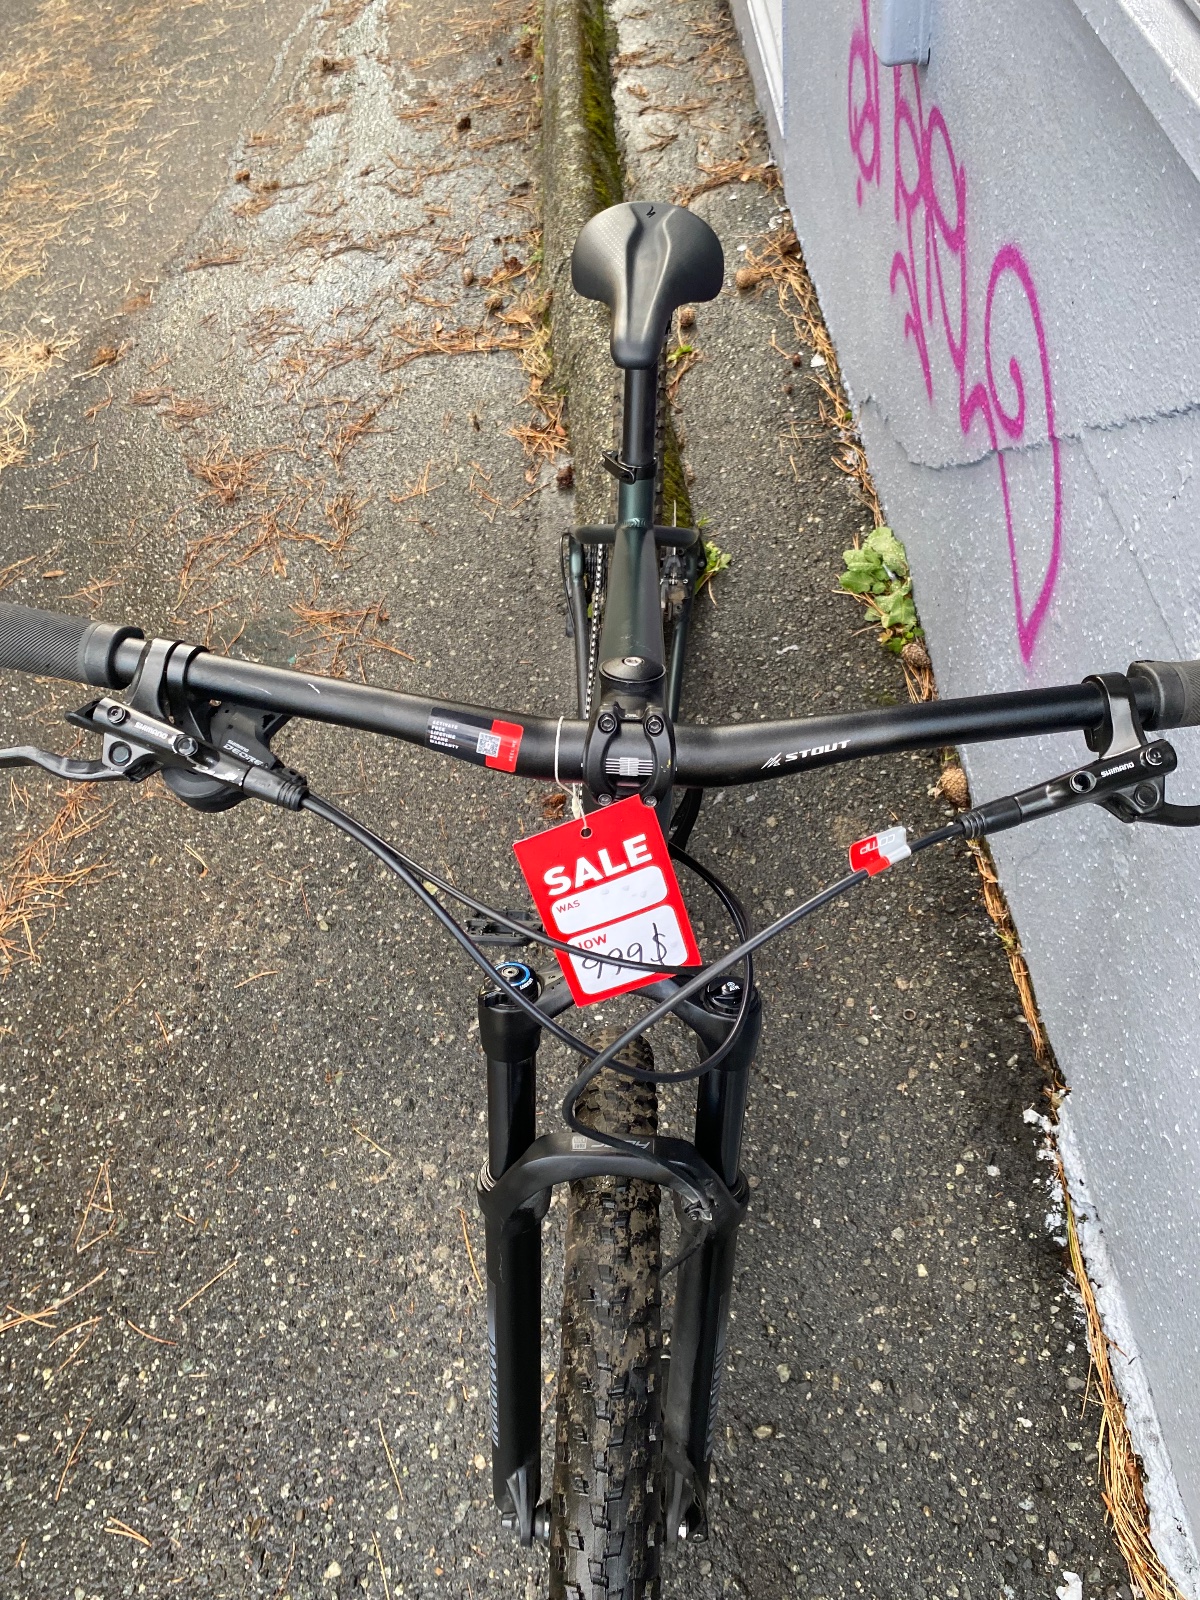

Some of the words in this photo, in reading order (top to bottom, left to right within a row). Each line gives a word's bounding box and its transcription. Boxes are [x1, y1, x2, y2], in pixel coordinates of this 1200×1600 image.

[134, 721, 168, 740] SHIMANO
[432, 720, 458, 730] ACTIVATE
[429, 735, 449, 743] FRAME
[430, 730, 456, 740] LIFETIME
[429, 739, 459, 749] WARRANTY
[785, 740, 851, 762] STOUT
[223, 743, 264, 767] DEORE
[1100, 761, 1135, 778] SHIMANO
[543, 833, 653, 895] SALE
[556, 900, 581, 914] WAS
